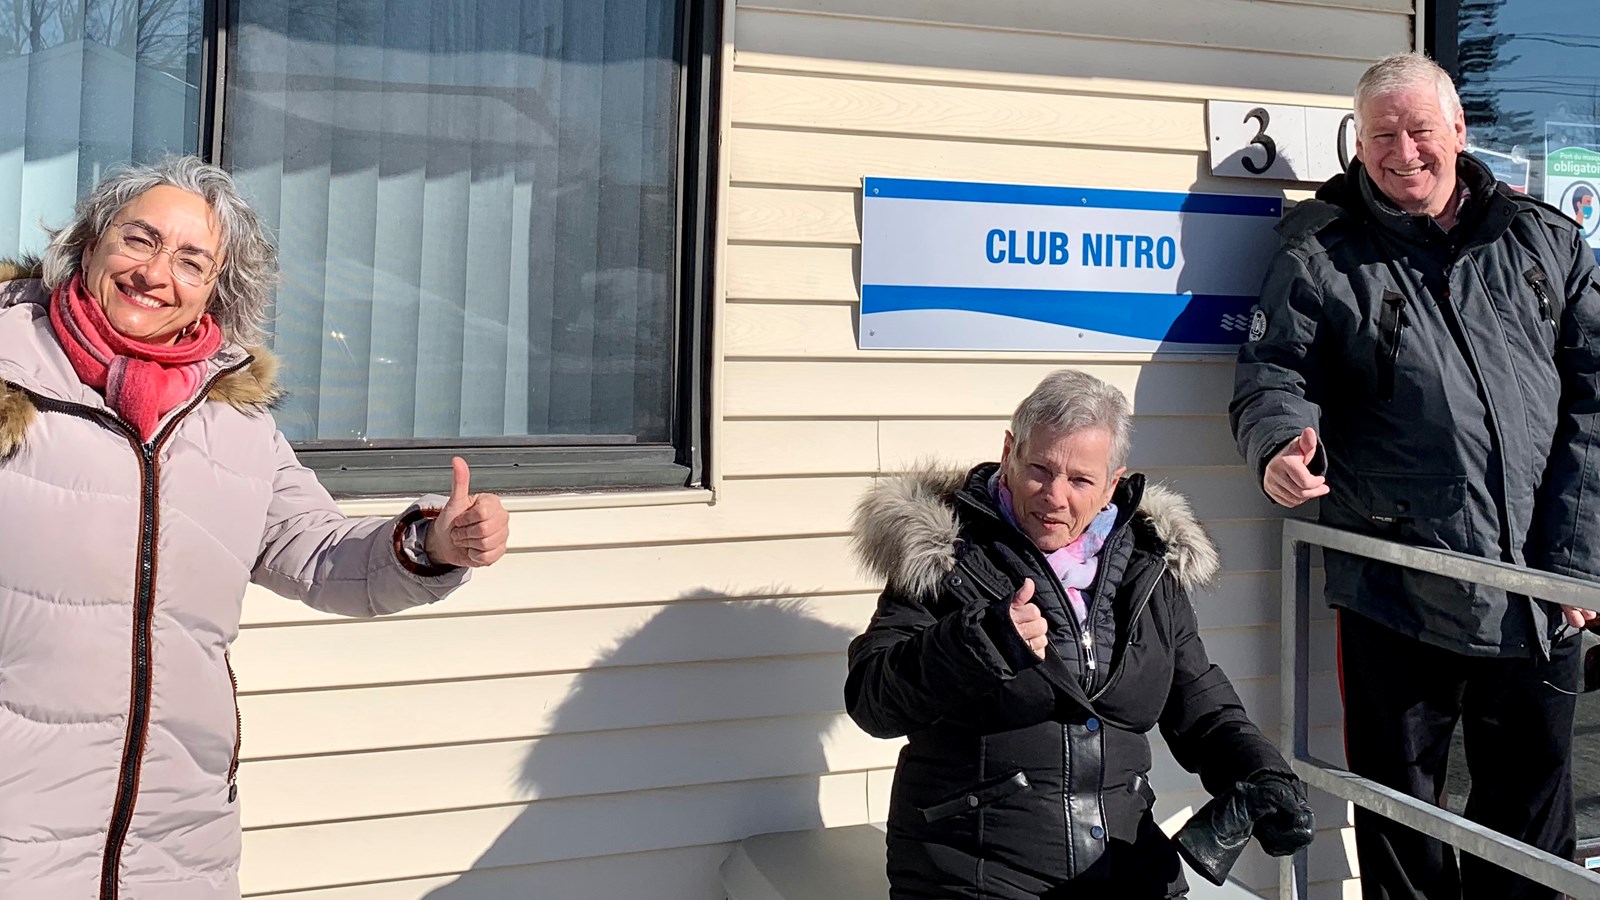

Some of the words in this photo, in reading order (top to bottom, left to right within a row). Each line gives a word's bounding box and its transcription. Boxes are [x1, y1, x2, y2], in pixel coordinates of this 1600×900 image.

[1560, 152, 1573, 160] Port
[1554, 161, 1600, 175] obligatoi
[986, 229, 1068, 265] CLUB
[1082, 233, 1175, 269] NITRO
